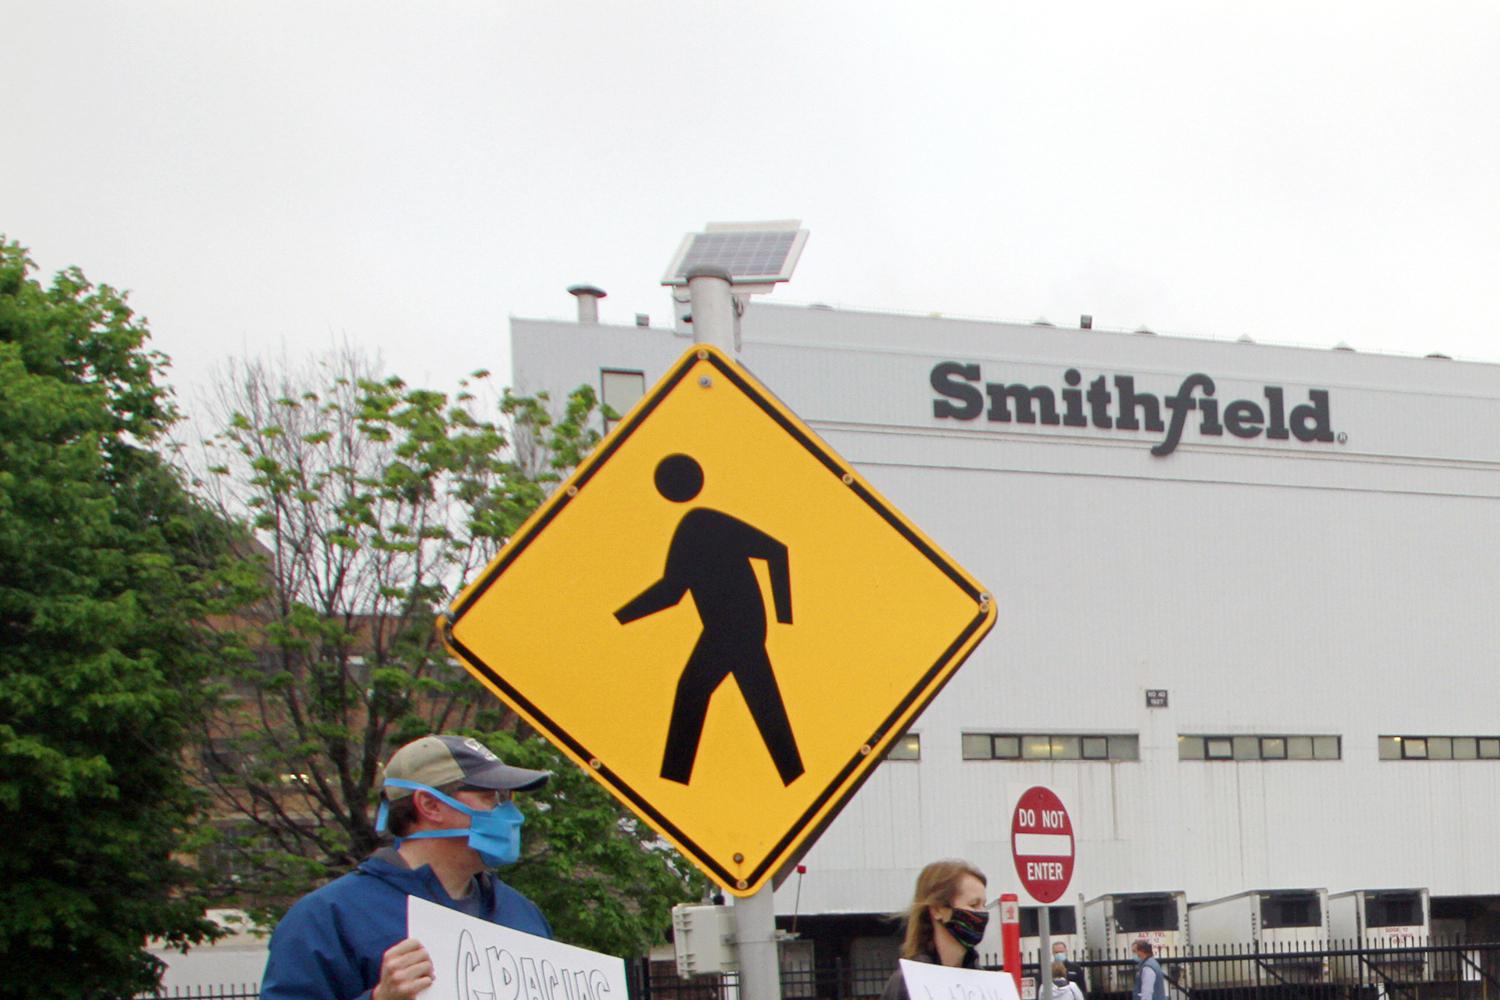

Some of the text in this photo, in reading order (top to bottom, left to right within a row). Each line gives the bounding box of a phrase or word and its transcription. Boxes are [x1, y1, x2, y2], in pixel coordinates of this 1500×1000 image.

[930, 361, 1334, 457] Smithfield
[1019, 808, 1065, 828] DO NOT
[1027, 862, 1064, 881] ENTER
